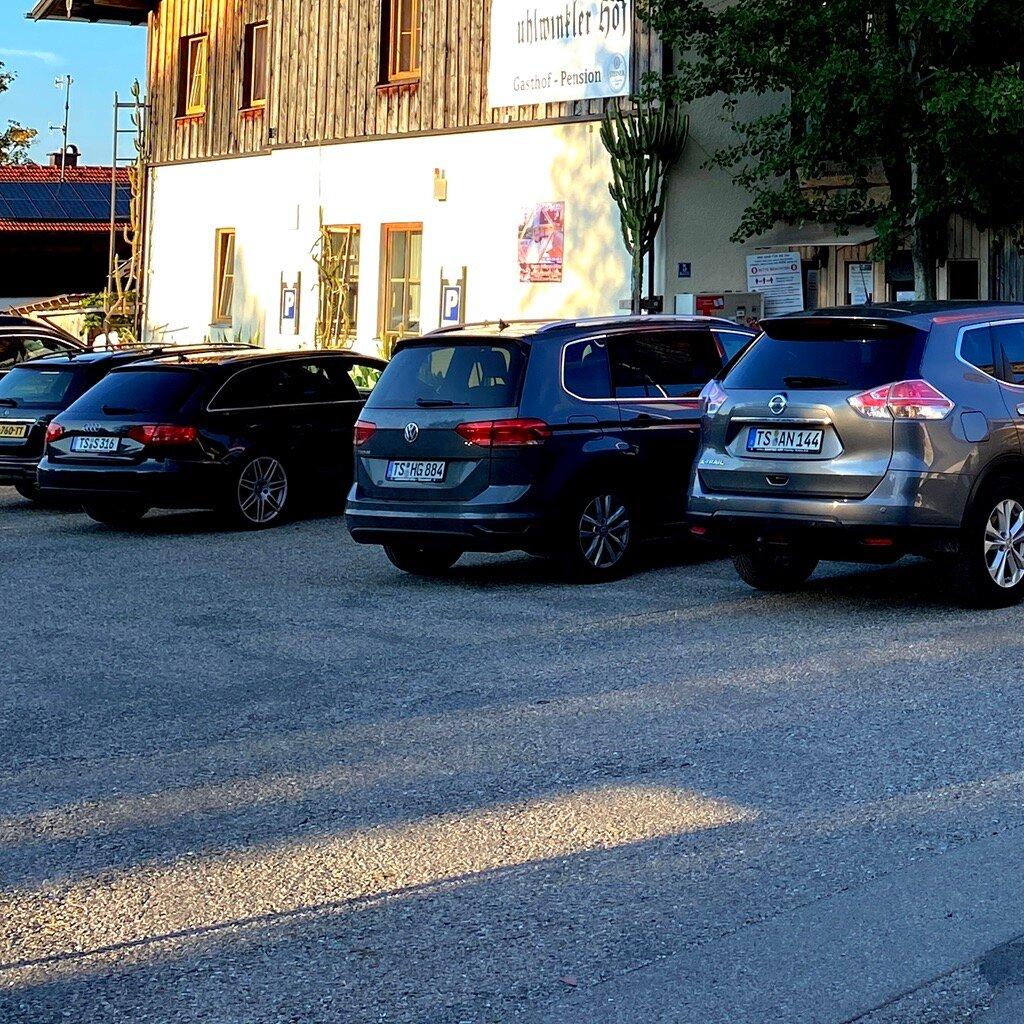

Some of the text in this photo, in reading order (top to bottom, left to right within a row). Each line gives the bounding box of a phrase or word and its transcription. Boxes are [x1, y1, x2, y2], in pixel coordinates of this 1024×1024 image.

[513, 72, 552, 92] Gasthof
[560, 68, 602, 87] Pension
[444, 288, 458, 318] P
